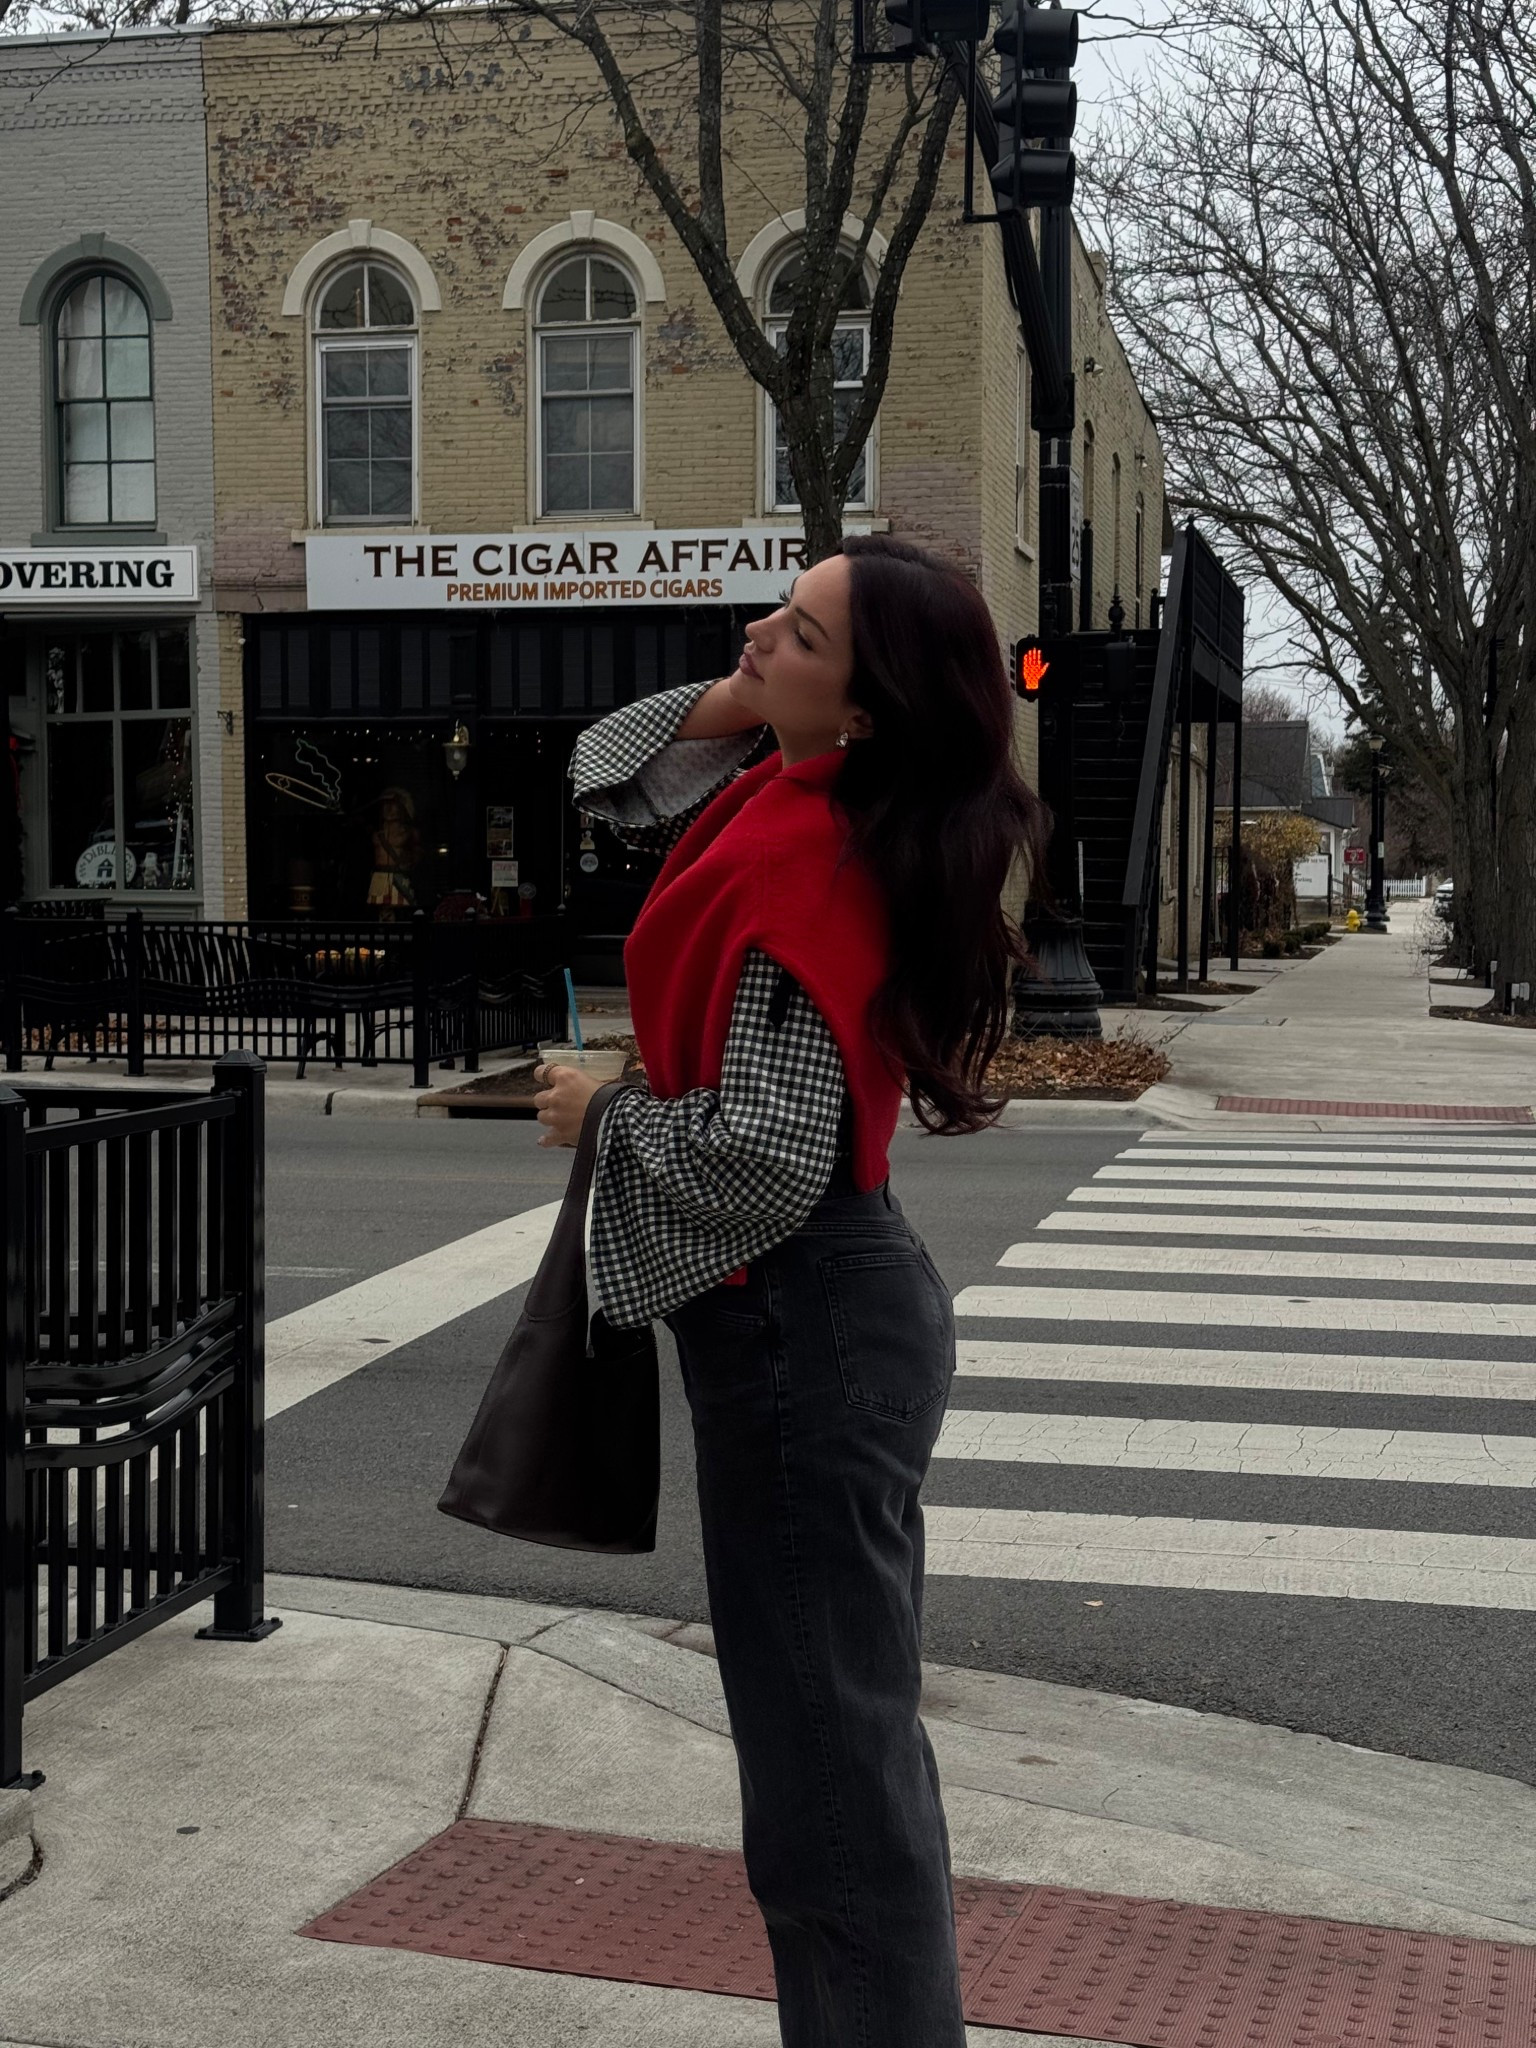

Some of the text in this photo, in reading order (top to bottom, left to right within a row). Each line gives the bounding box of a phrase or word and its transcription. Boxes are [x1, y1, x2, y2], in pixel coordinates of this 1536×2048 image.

[363, 537, 808, 577] THE CIGAR AFFAIR
[446, 578, 723, 601] PREMIUM IMPORTED CIGARS
